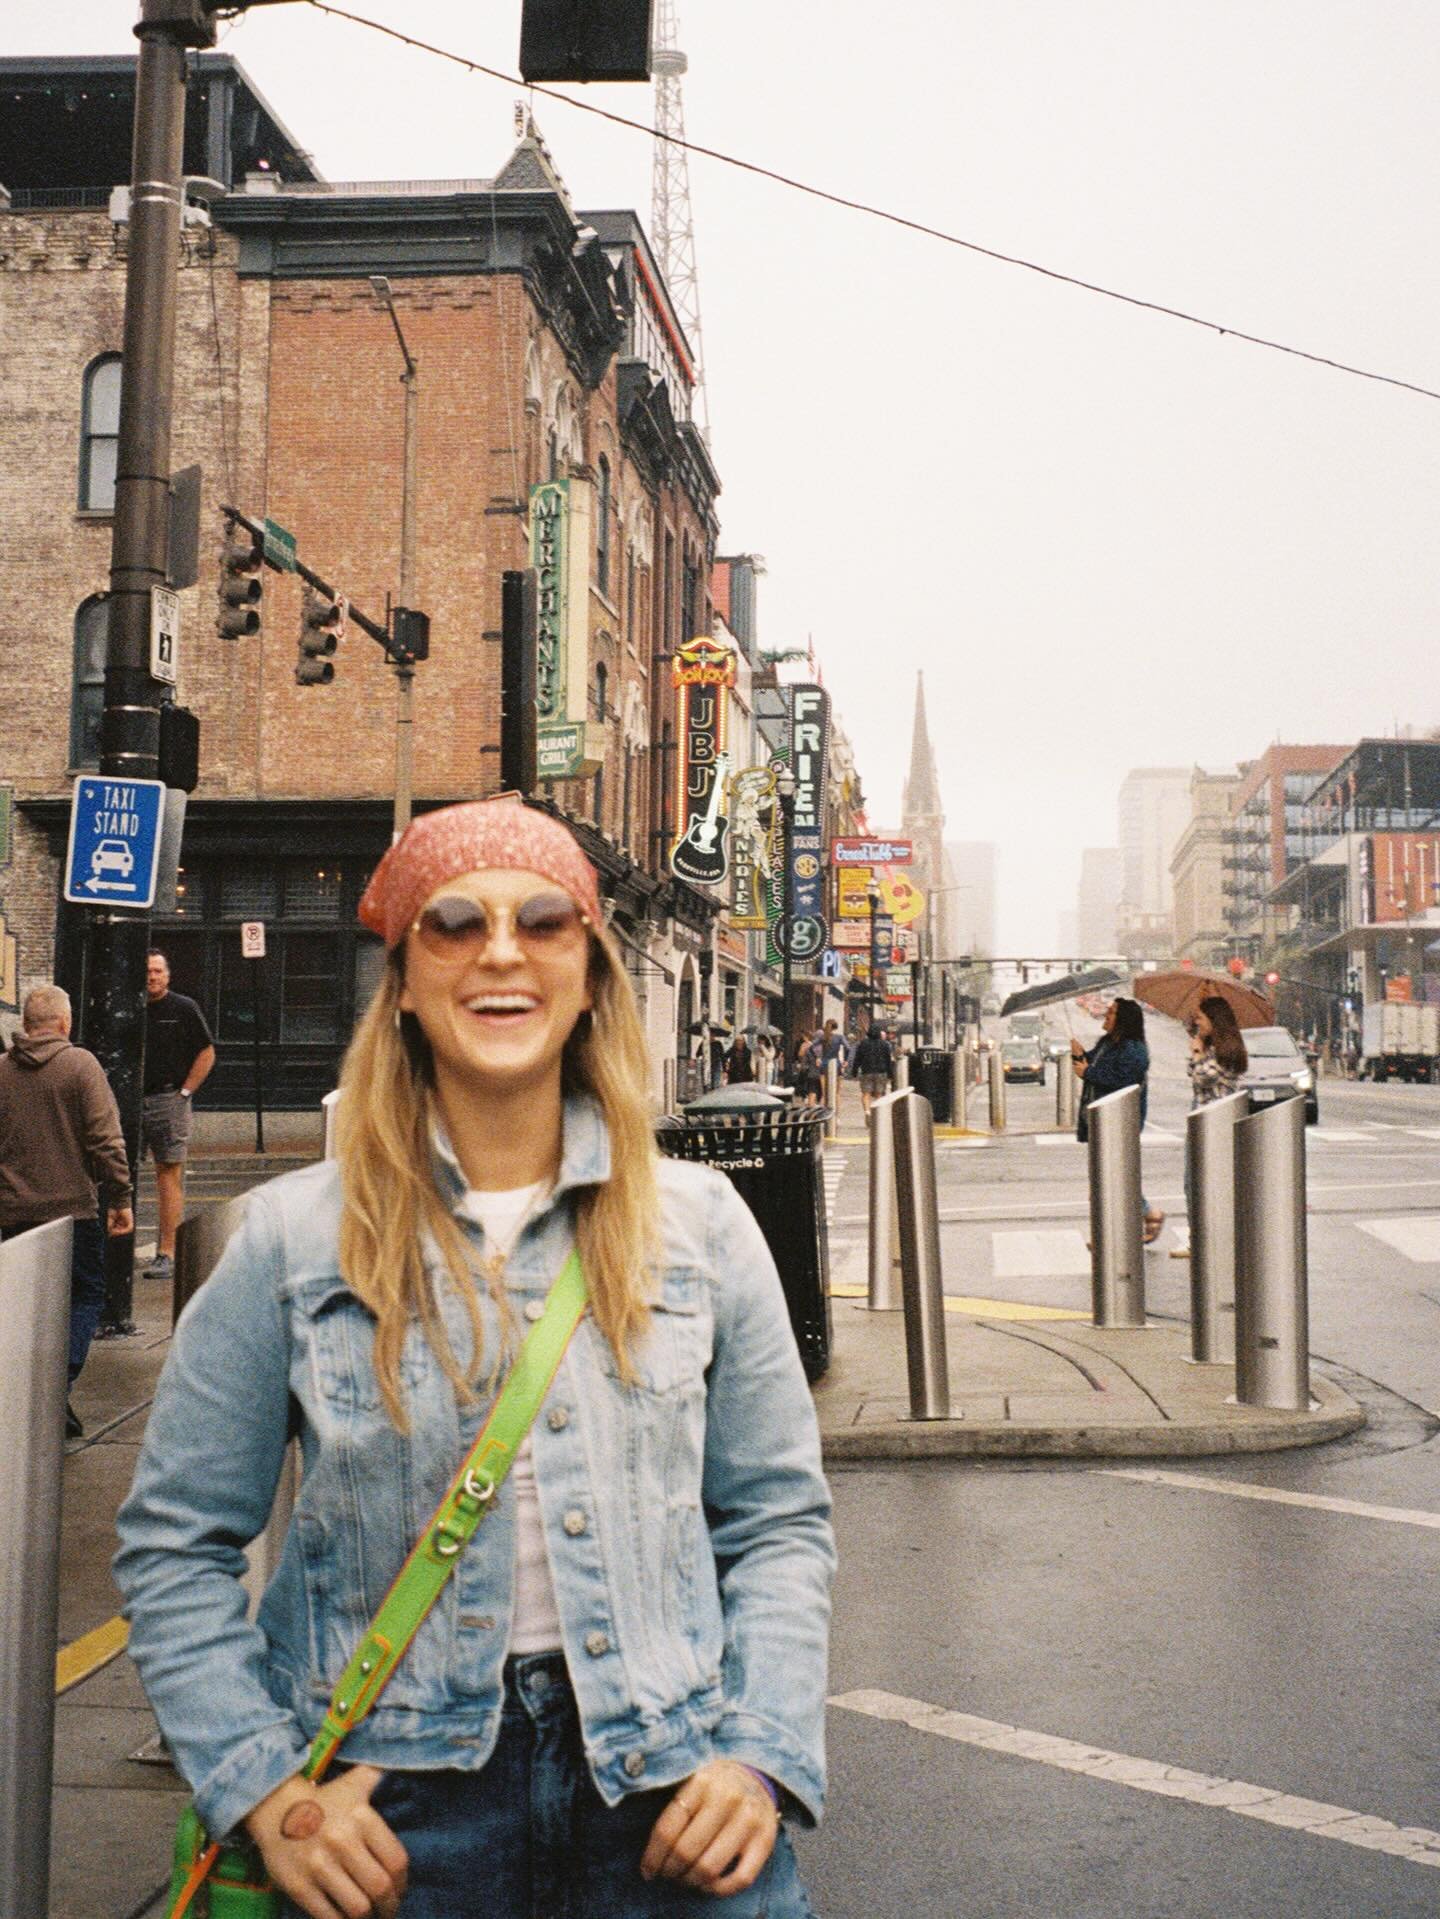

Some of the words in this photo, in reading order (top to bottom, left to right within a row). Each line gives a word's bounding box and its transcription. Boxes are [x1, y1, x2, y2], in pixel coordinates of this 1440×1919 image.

[537, 498, 557, 716] MERCHANTS
[540, 751, 568, 766] GRILL
[688, 697, 716, 797] JBJ
[104, 786, 136, 810] TAXI
[93, 811, 139, 837] STAND
[794, 838, 820, 849] FANS
[708, 1157, 753, 1170] Recycle
